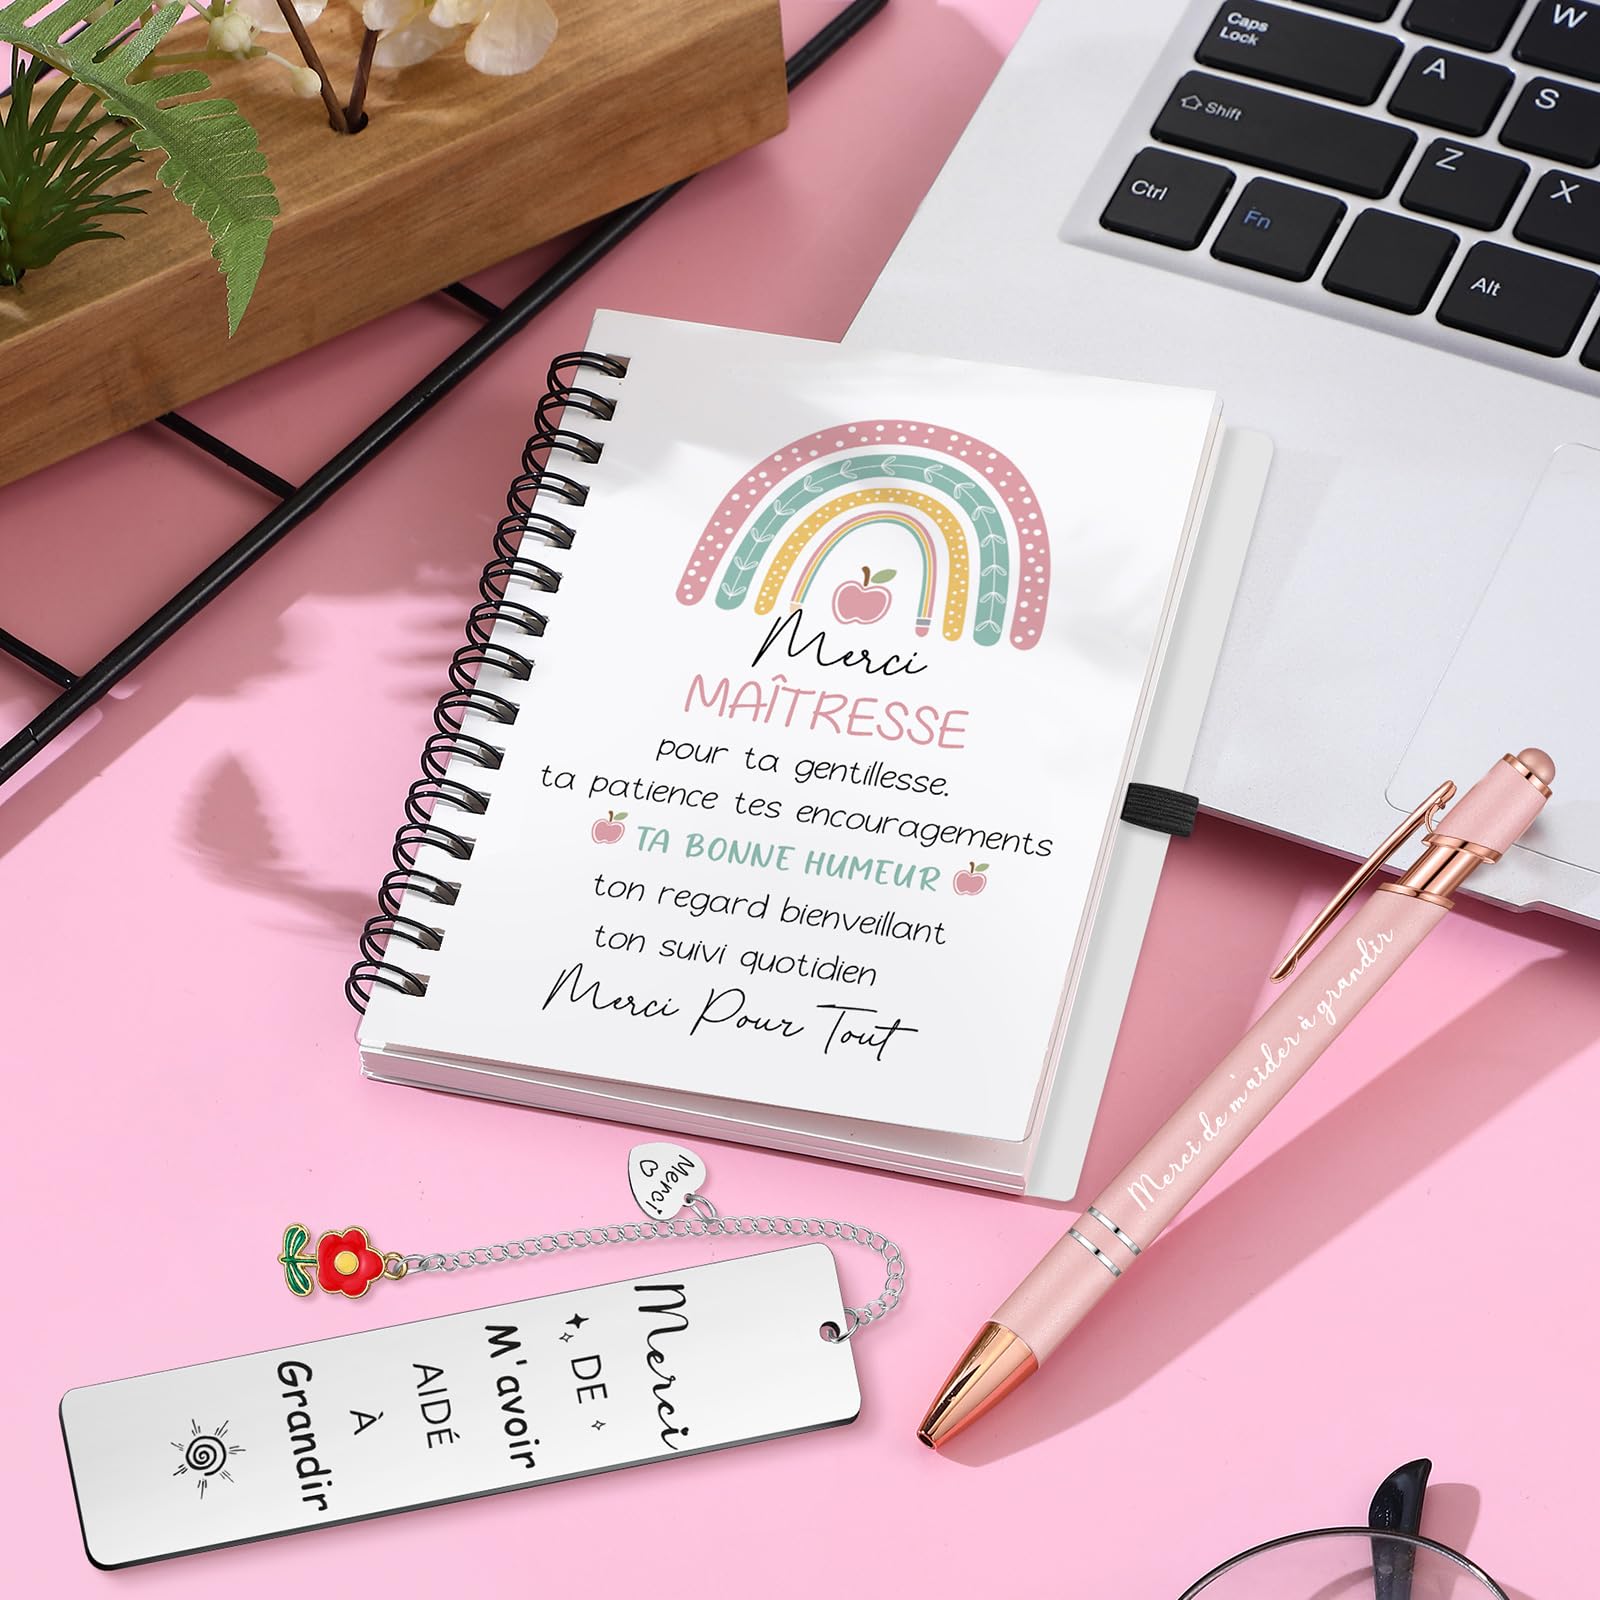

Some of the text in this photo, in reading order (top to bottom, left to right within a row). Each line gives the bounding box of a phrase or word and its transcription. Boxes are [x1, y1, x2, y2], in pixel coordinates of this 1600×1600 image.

[1219, 26, 1260, 46] Lock
[1227, 11, 1269, 33] Caps
[1553, 4, 1588, 28] W
[1422, 58, 1447, 81] A
[1205, 102, 1241, 120] Shift
[1535, 89, 1559, 109] S
[1436, 148, 1464, 170] Z
[1131, 179, 1168, 201] Ctrl
[1550, 180, 1580, 203] X
[1243, 210, 1271, 229] Fn
[1470, 277, 1501, 298] Alt
[752, 609, 928, 676] Merci
[684, 675, 969, 749] MAÎTRESSE
[656, 739, 948, 796] pour ta gentillesse.
[542, 765, 1053, 857] ta patience tes encouragements
[638, 827, 940, 891] TA BONNE HUMEUR
[595, 874, 946, 944] ton regard bienveillant
[595, 925, 876, 986] ton suivi quotidien
[542, 963, 918, 1061] Merci Pour Tout
[1128, 930, 1393, 1211] Merci de m'aider à grandir
[645, 1154, 695, 1215] Merci
[571, 1355, 608, 1404] DE
[634, 1284, 690, 1450] Merci
[350, 1409, 383, 1436] À
[413, 1363, 460, 1449] AIDÉ
[485, 1325, 540, 1468] M'avoir
[277, 1361, 332, 1511] Grandir
